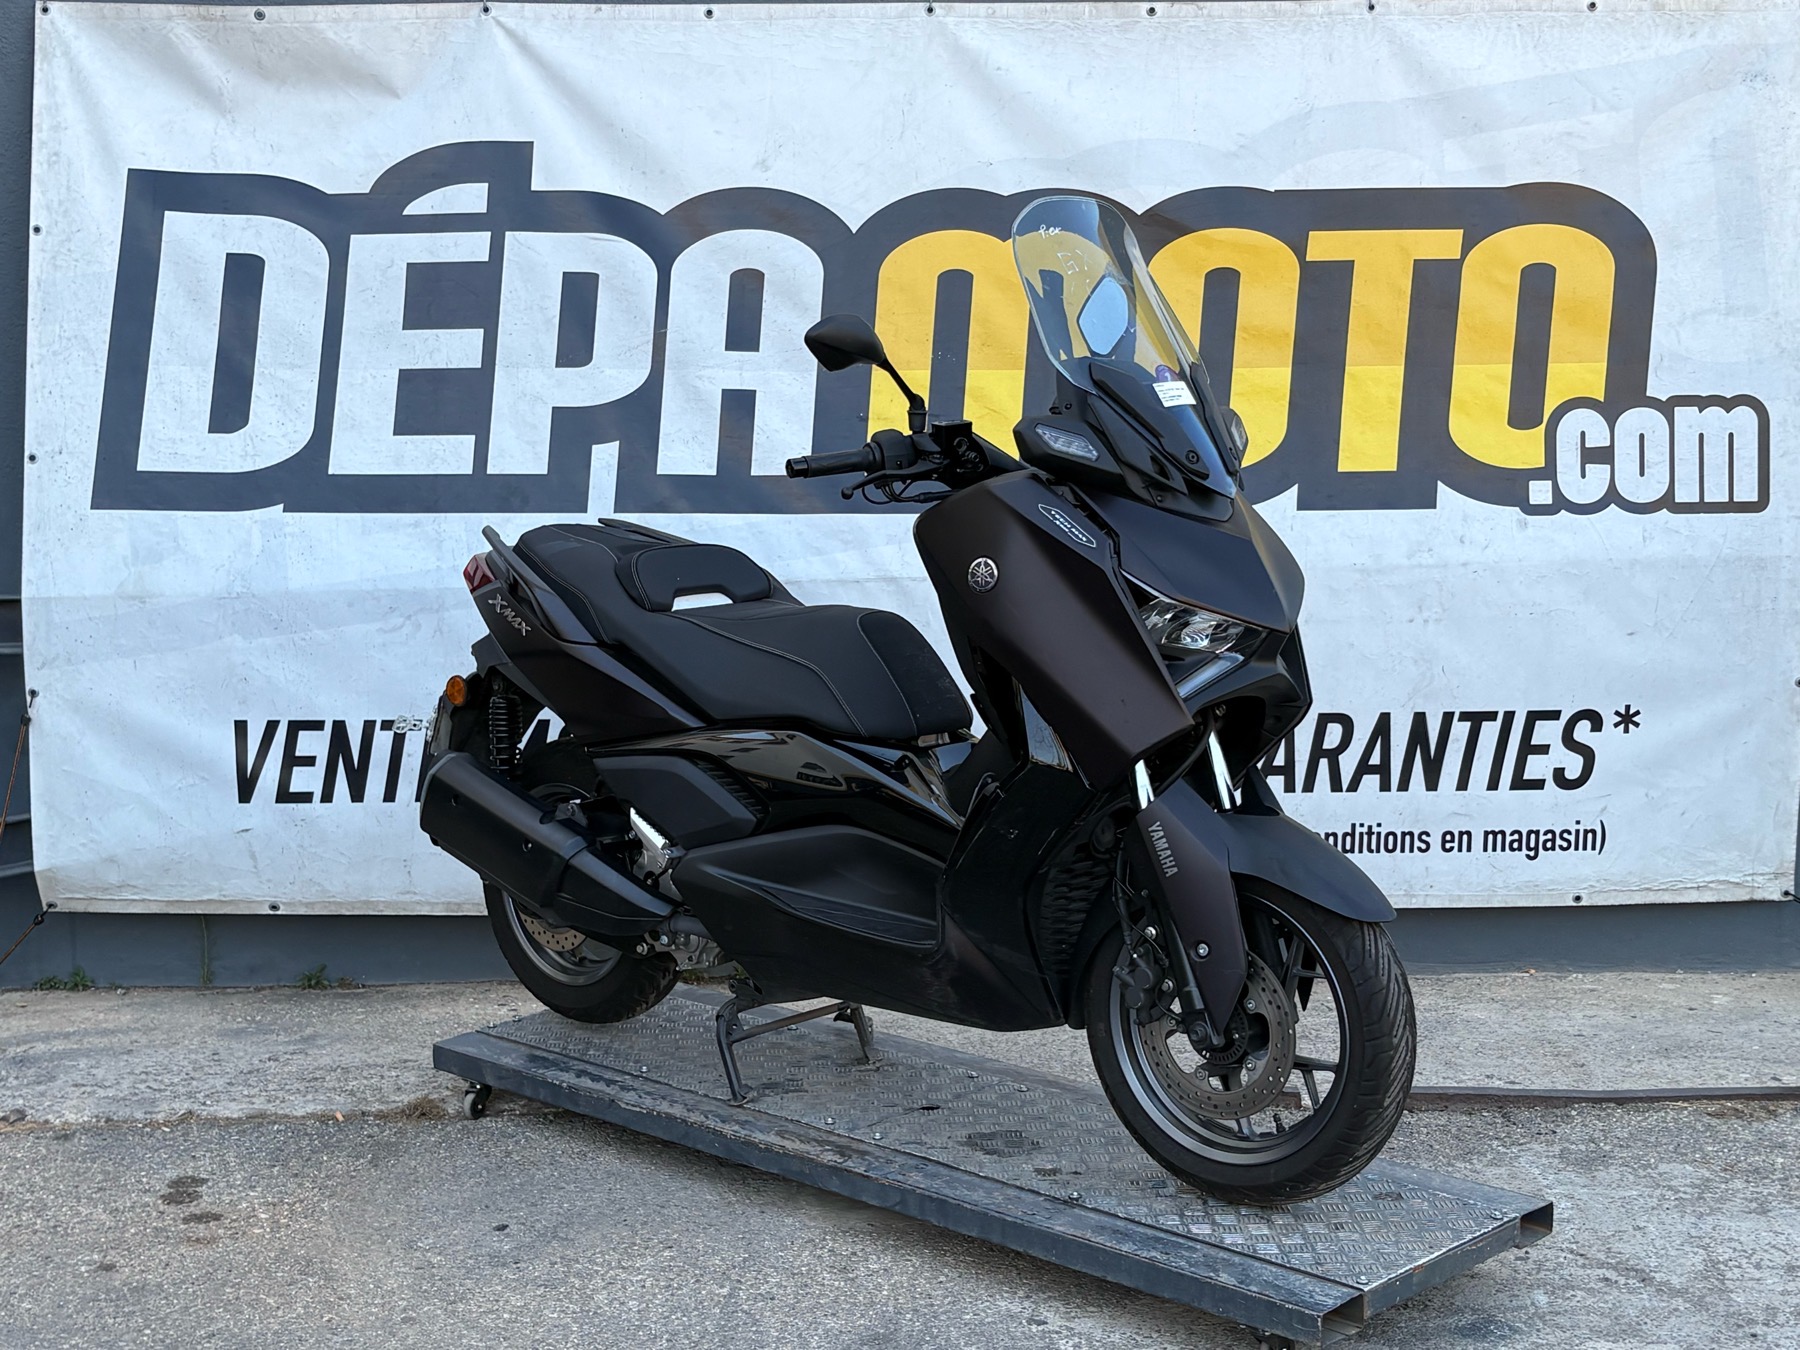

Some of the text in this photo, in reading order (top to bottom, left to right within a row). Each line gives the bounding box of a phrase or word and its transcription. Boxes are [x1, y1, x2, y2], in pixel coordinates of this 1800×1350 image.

[1258, 704, 1641, 794] ARANTIES
[1148, 821, 1178, 877] YAMAHA
[1317, 819, 1607, 861] nditions en magasin)
